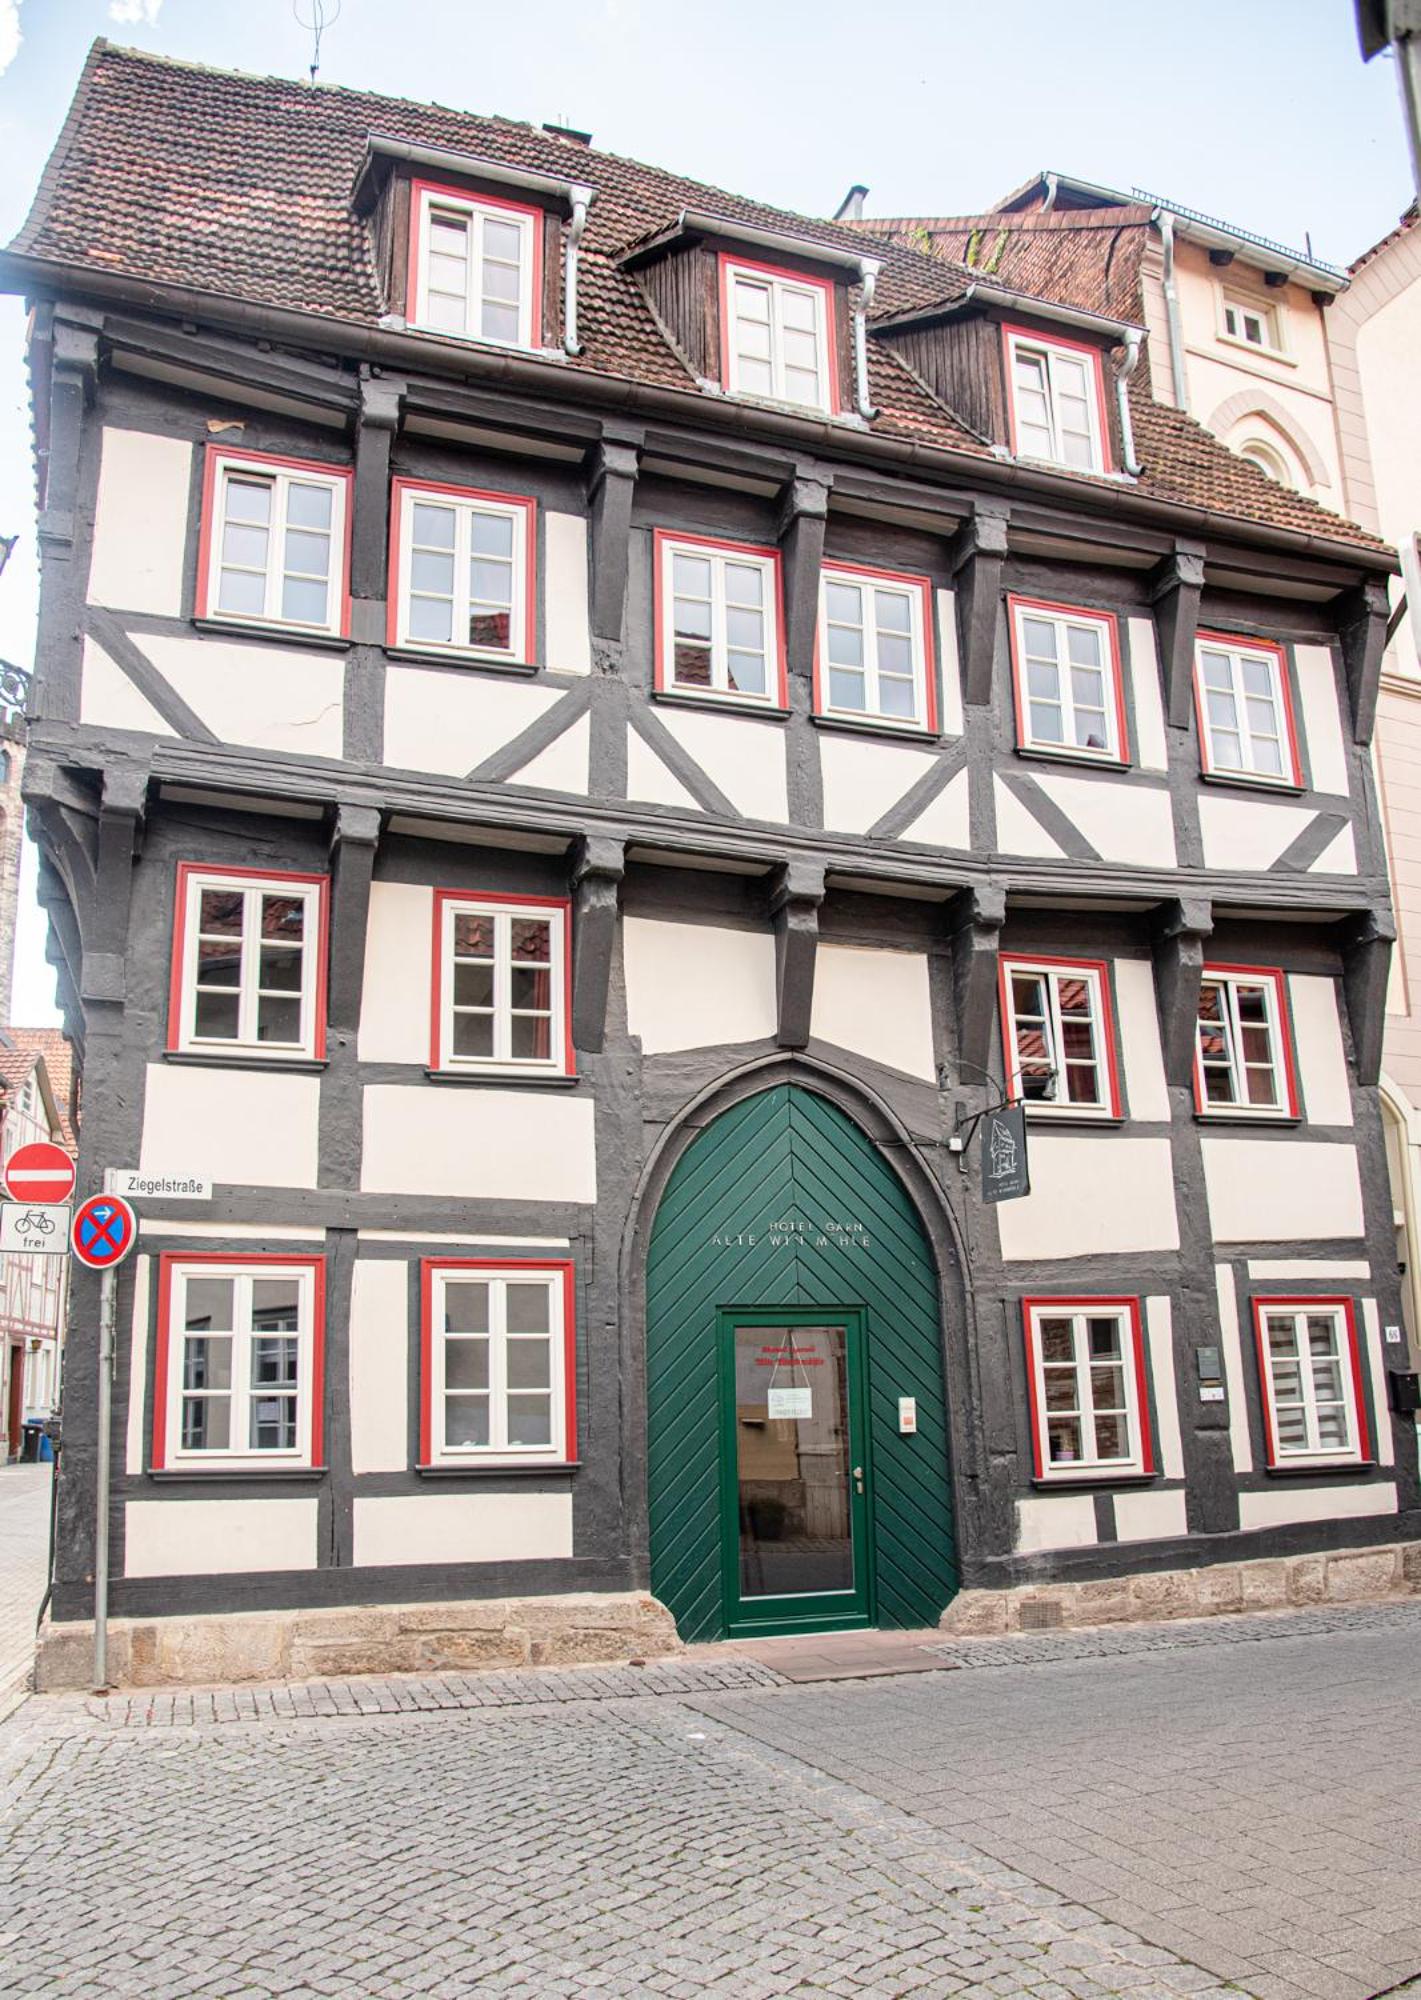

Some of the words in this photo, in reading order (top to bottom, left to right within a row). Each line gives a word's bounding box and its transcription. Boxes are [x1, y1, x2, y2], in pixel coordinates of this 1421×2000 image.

[127, 1176, 204, 1195] Ziegelstraße
[769, 1222, 813, 1232] HOTEL
[23, 1237, 45, 1248] frei
[711, 1235, 756, 1246] ALTE
